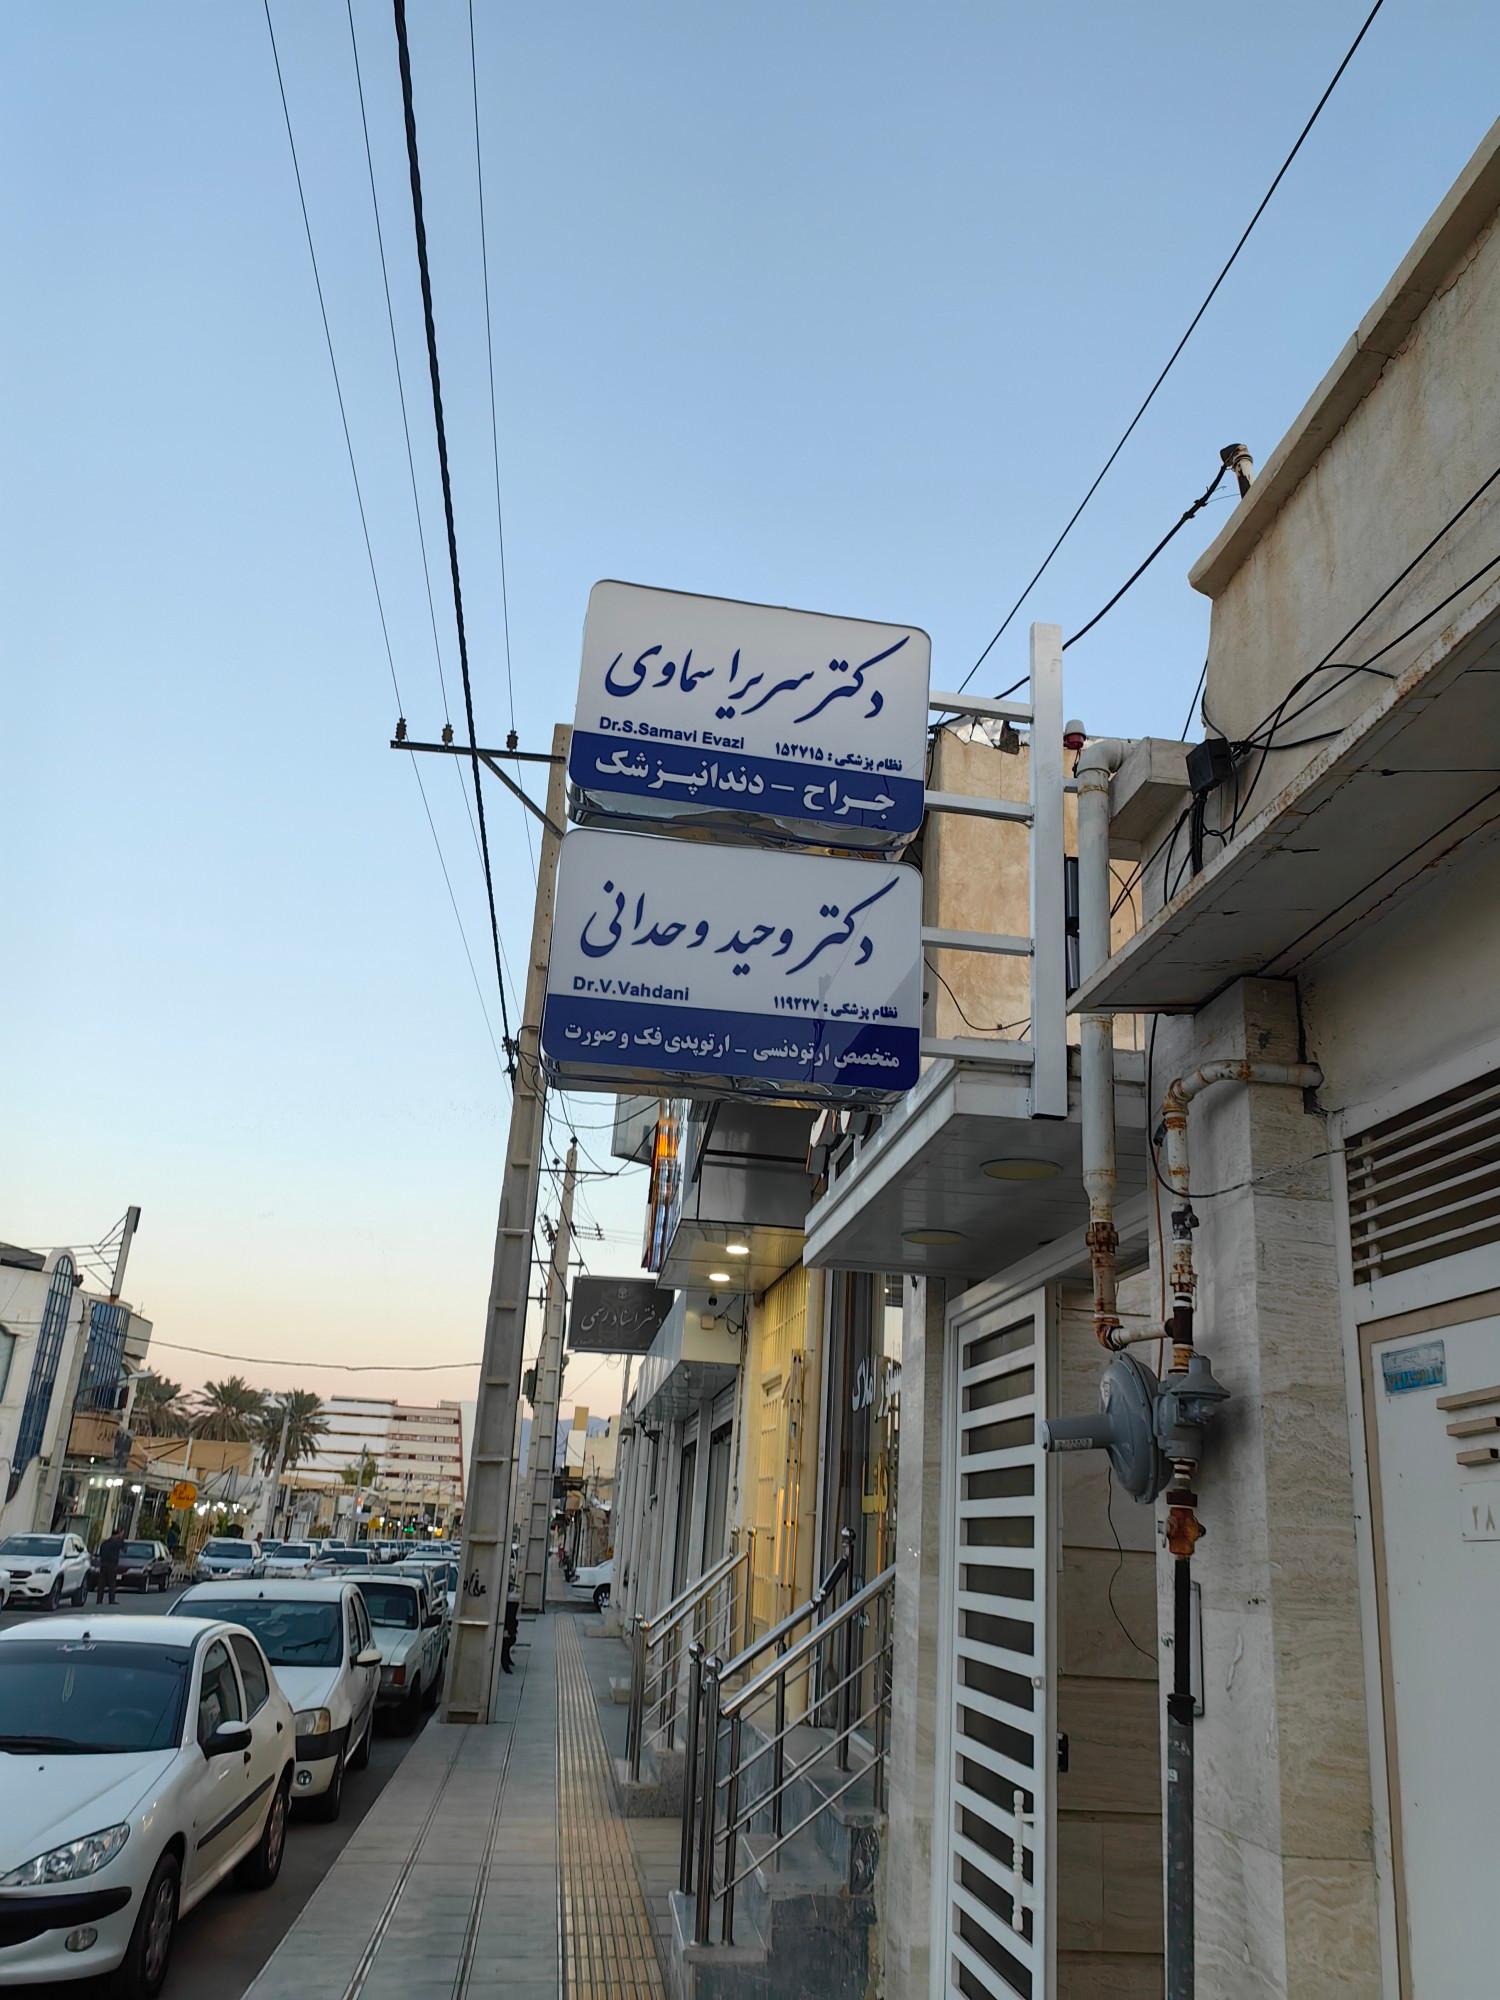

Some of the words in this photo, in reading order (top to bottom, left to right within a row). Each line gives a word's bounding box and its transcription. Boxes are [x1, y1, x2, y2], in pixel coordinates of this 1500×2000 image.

[604, 644, 715, 697] سماوی
[793, 635, 911, 724] دکتر
[702, 731, 745, 750] Evazi
[594, 749, 765, 797] دندانپزشک
[834, 753, 874, 772] پزشکی
[876, 758, 903, 772] نظام
[803, 779, 896, 821] جراح
[579, 879, 710, 959] وحدانی
[784, 876, 900, 976] دکتر
[713, 924, 794, 977] وحید
[573, 975, 690, 1001] Dr.V.Vahdani
[830, 1002, 870, 1020] پزشکی
[872, 1005, 898, 1021] نظام
[564, 1023, 617, 1047] صورت
[618, 1032, 629, 1049] و
[633, 1026, 663, 1046] فک
[664, 1033, 731, 1058] ارتوپدی
[753, 1039, 831, 1067] ارتودنسی
[833, 1047, 900, 1069] متخصص
